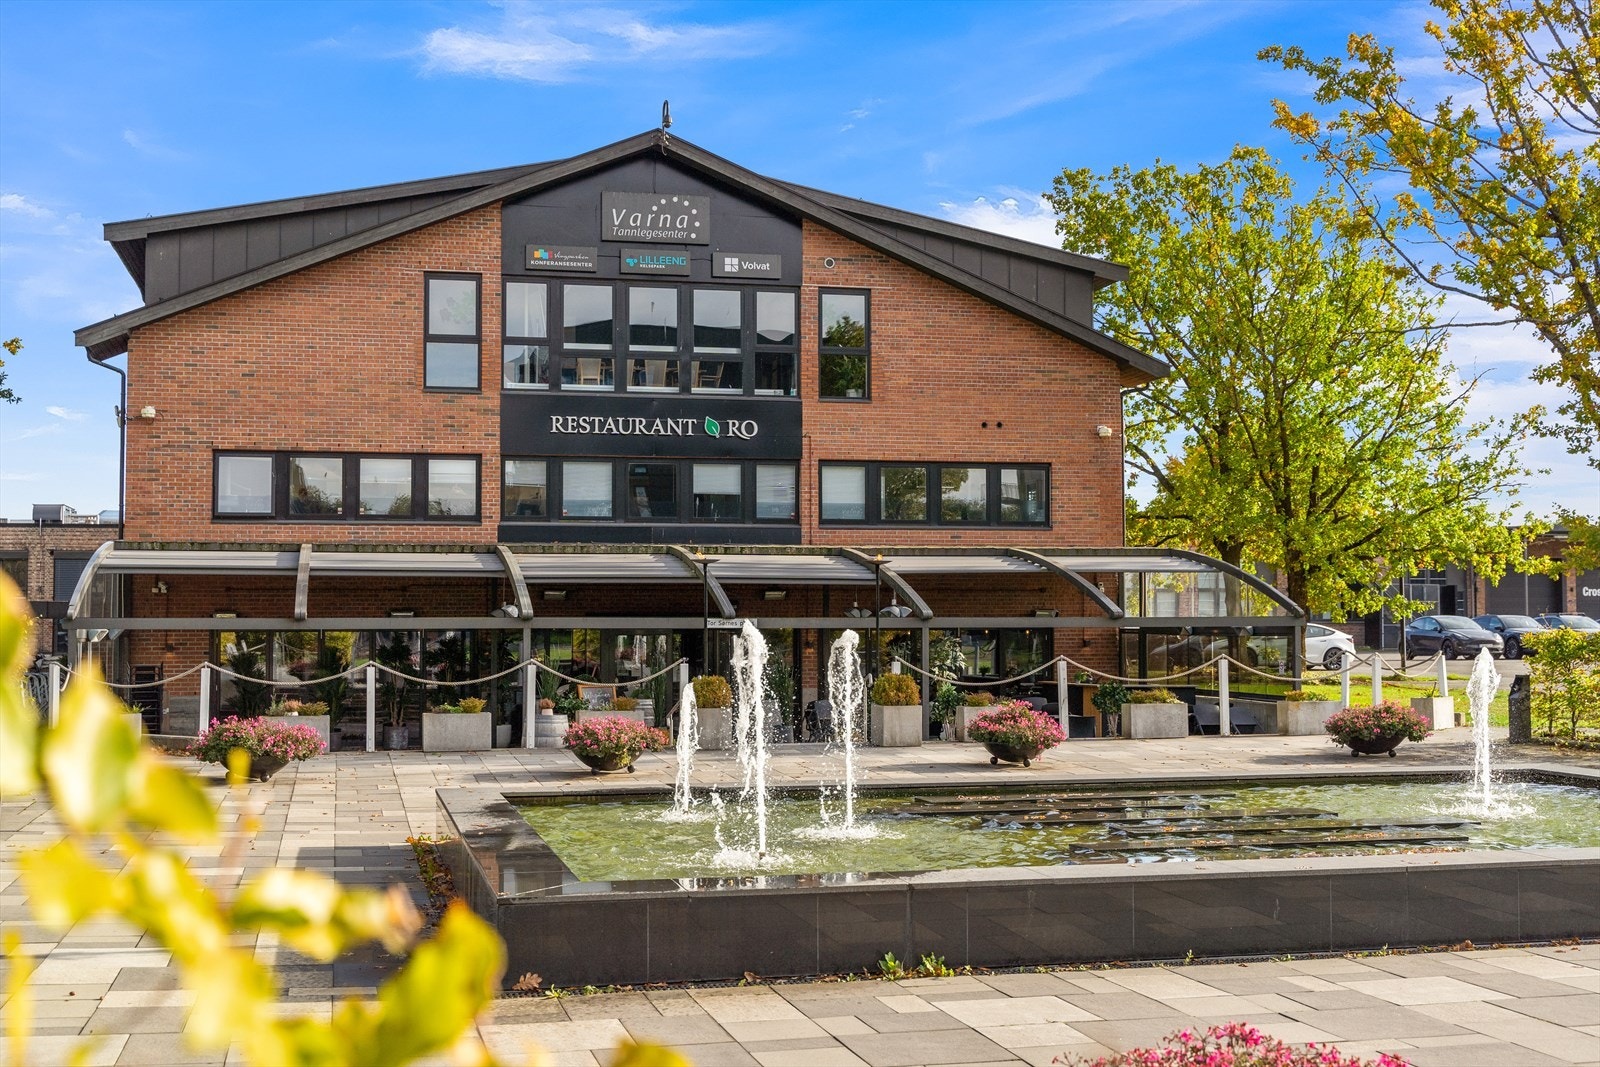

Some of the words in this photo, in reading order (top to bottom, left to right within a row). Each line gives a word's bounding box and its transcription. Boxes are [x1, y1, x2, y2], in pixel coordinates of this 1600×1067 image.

[612, 208, 689, 229] Varna
[612, 226, 688, 240] Tannlegesenter
[530, 259, 593, 268] KONFERANSESENTER
[640, 255, 687, 266] LILLEENG
[741, 261, 770, 271] Volvat
[550, 415, 697, 437] RESTAURANT
[726, 420, 758, 440] RO
